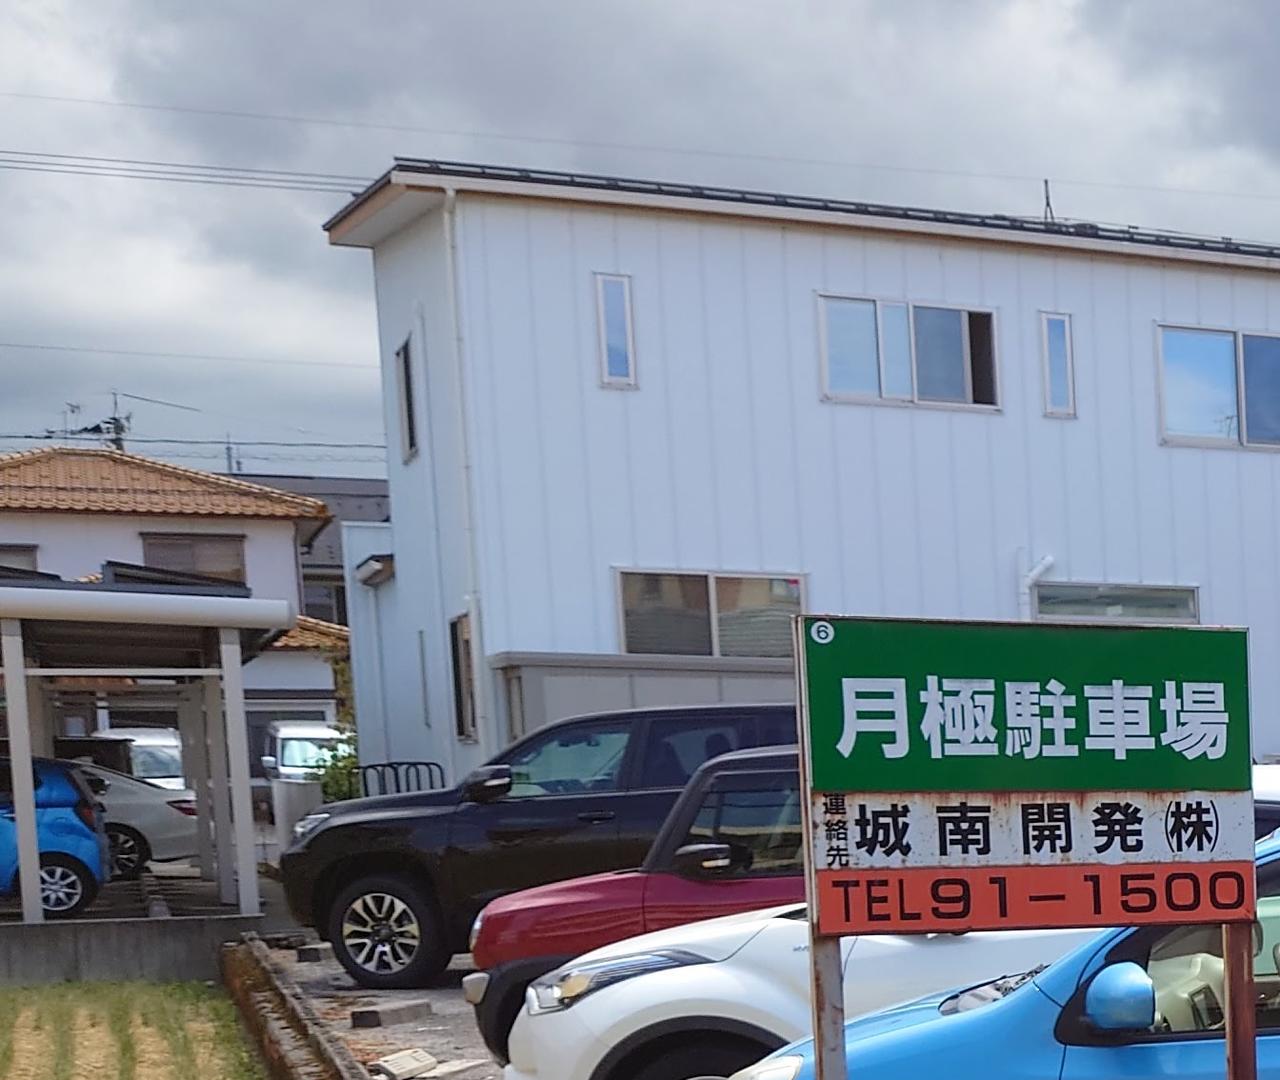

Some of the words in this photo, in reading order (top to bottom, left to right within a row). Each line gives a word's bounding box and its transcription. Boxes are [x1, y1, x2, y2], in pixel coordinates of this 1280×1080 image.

[816, 624, 829, 640] 6
[836, 675, 1229, 760] 月極駐車場
[822, 793, 850, 867] 連絡先
